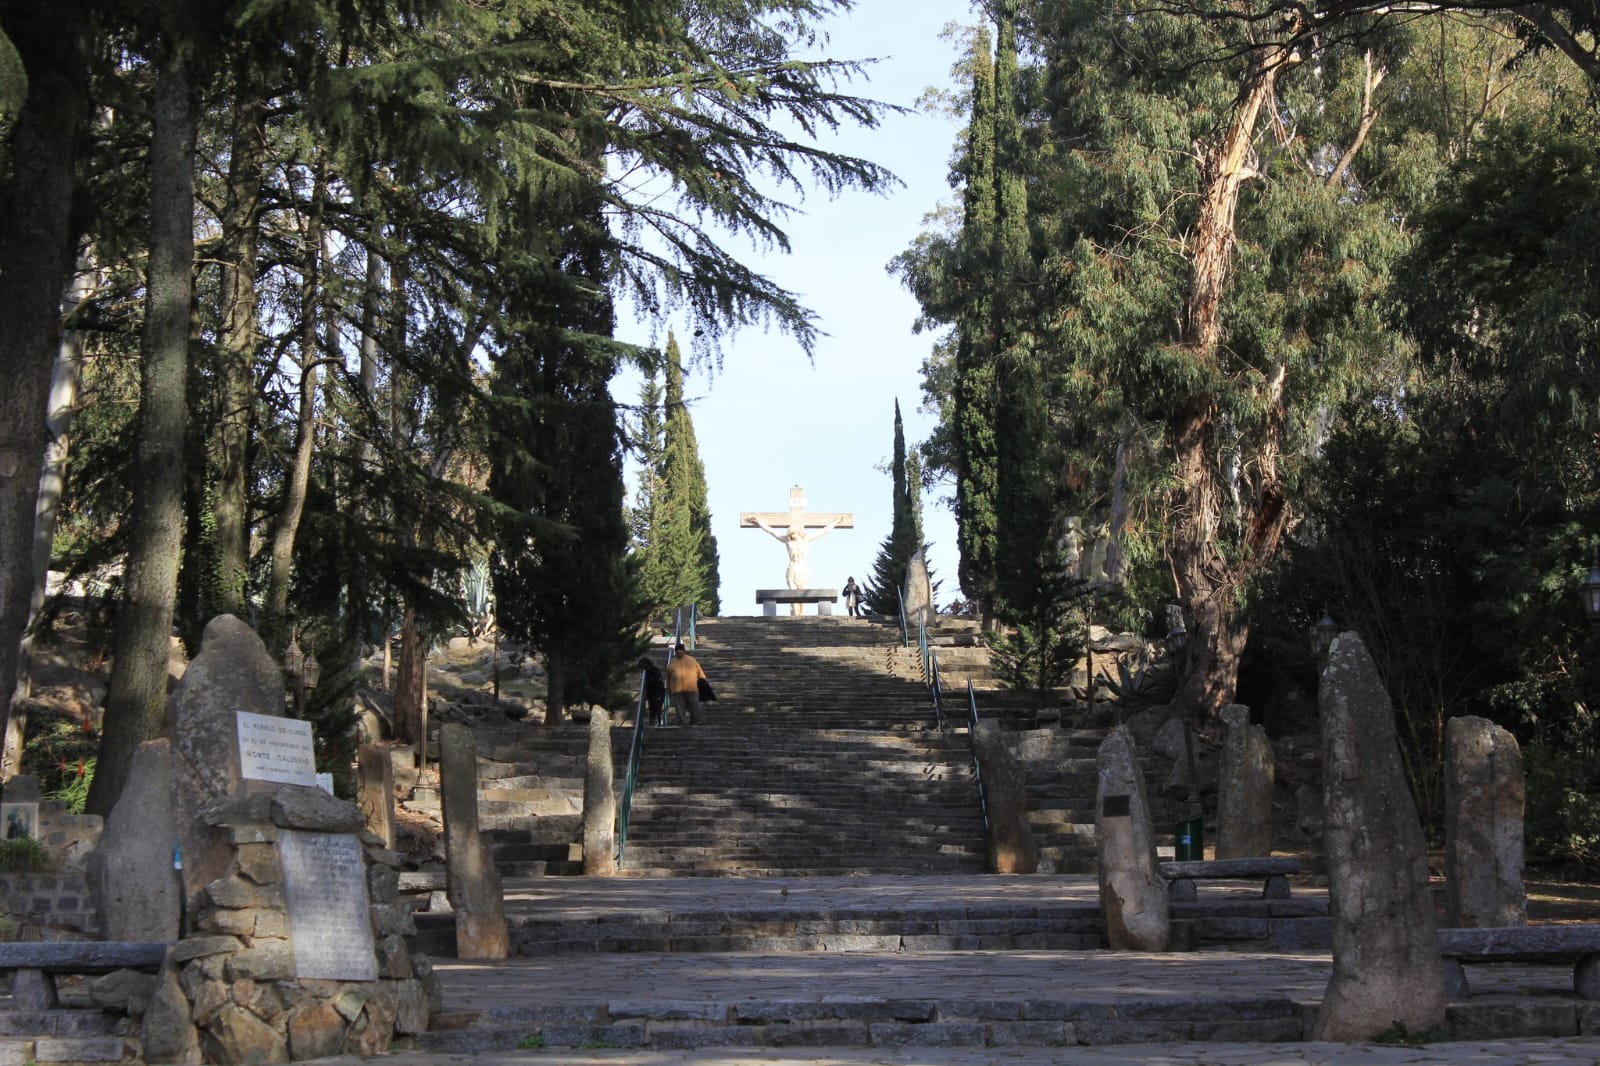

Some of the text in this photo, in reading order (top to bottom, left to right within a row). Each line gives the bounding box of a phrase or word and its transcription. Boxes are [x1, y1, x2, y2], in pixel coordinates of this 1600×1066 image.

[253, 723, 275, 733] PUEBLO
[247, 751, 310, 766] MONTE CALVARIO
